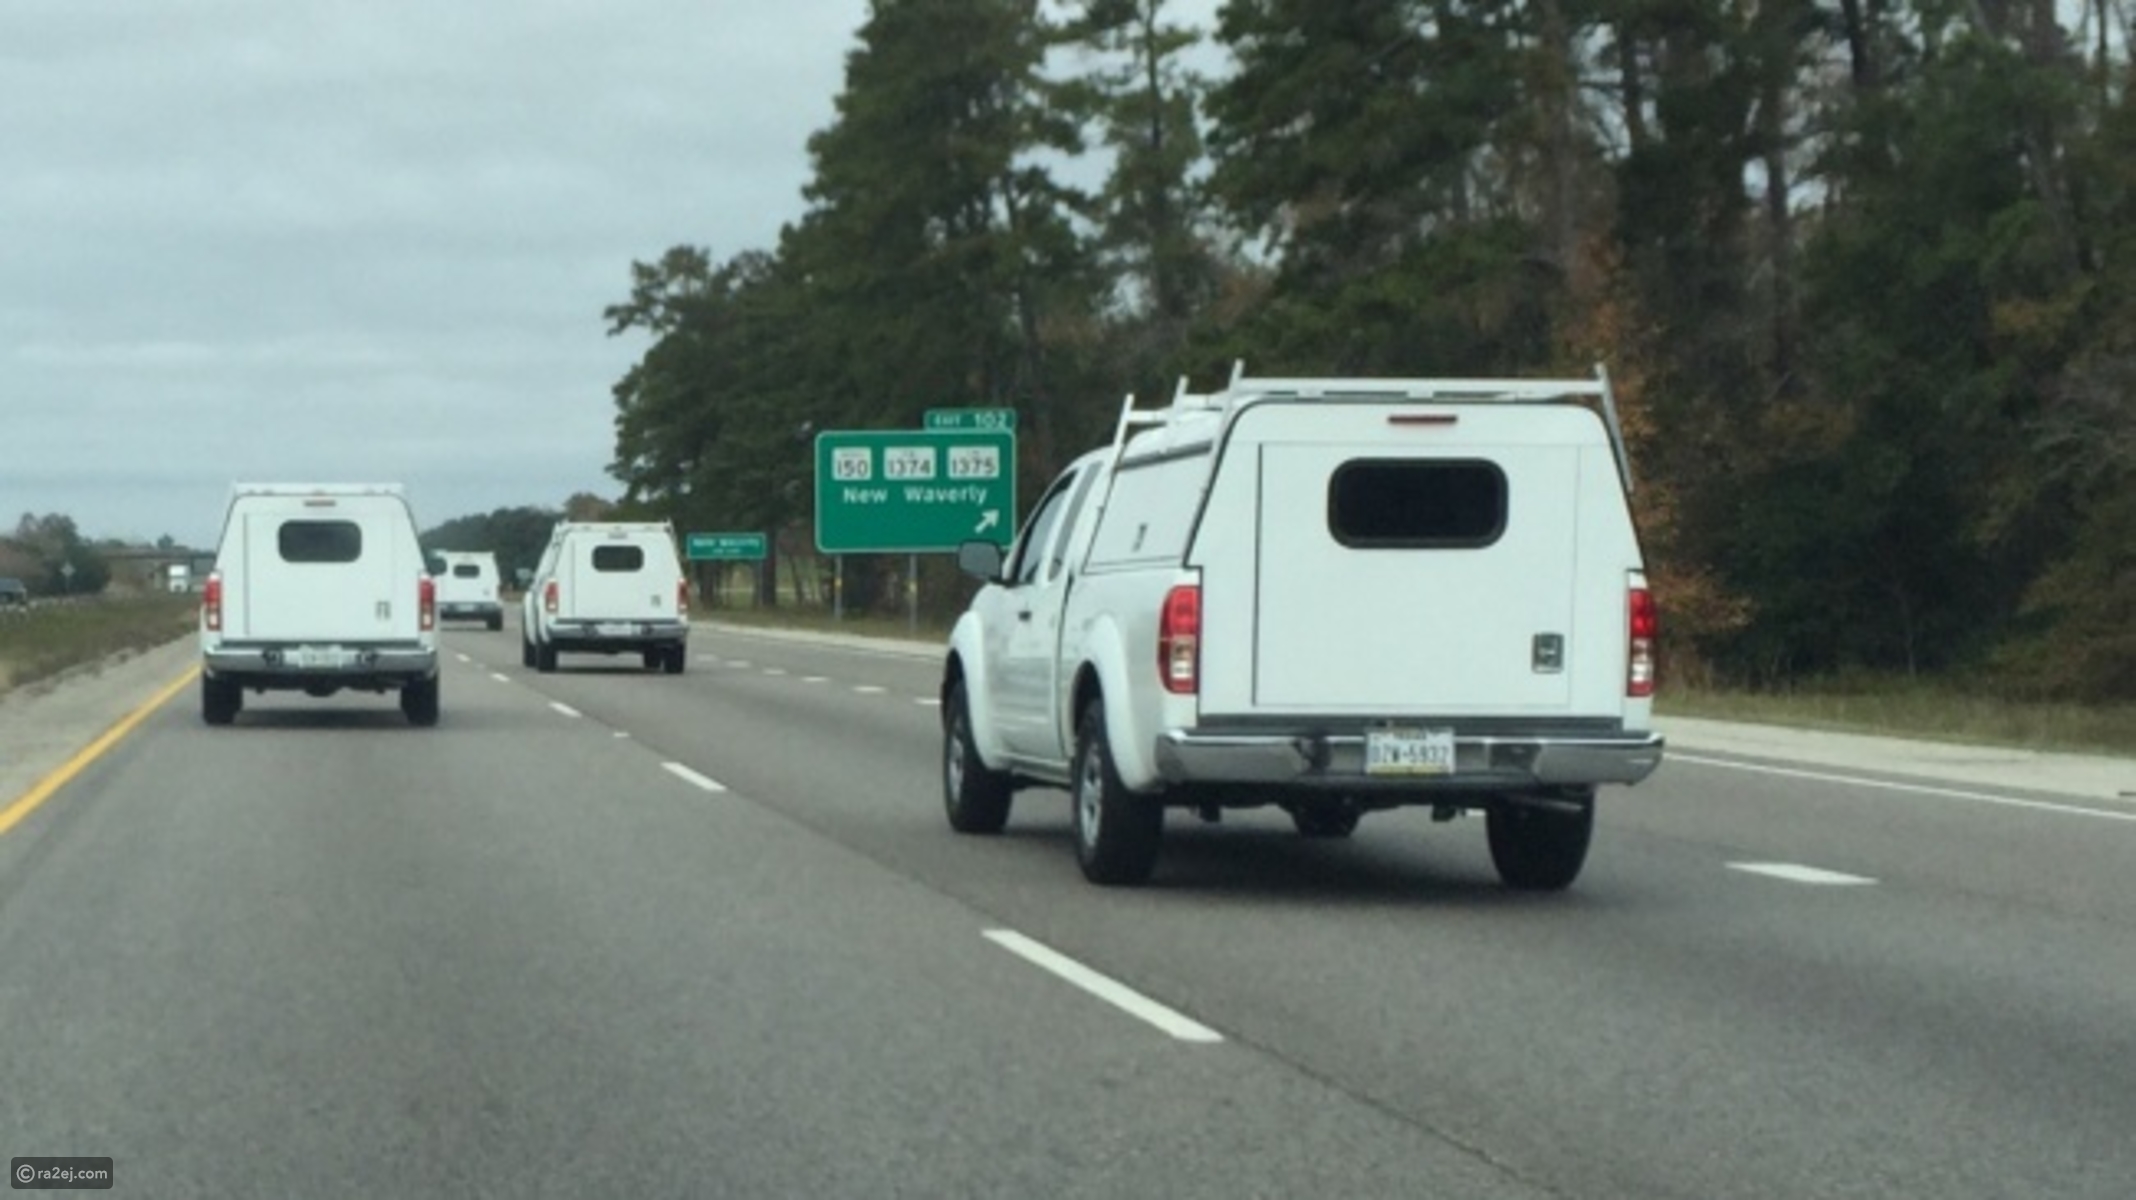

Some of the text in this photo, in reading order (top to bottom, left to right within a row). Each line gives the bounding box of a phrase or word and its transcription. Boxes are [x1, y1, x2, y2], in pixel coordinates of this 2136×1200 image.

[974, 412, 1007, 428] 102
[837, 459, 869, 476] 150
[889, 459, 931, 476] 1374
[951, 458, 996, 475] 1375
[843, 484, 988, 505] New Waverly
